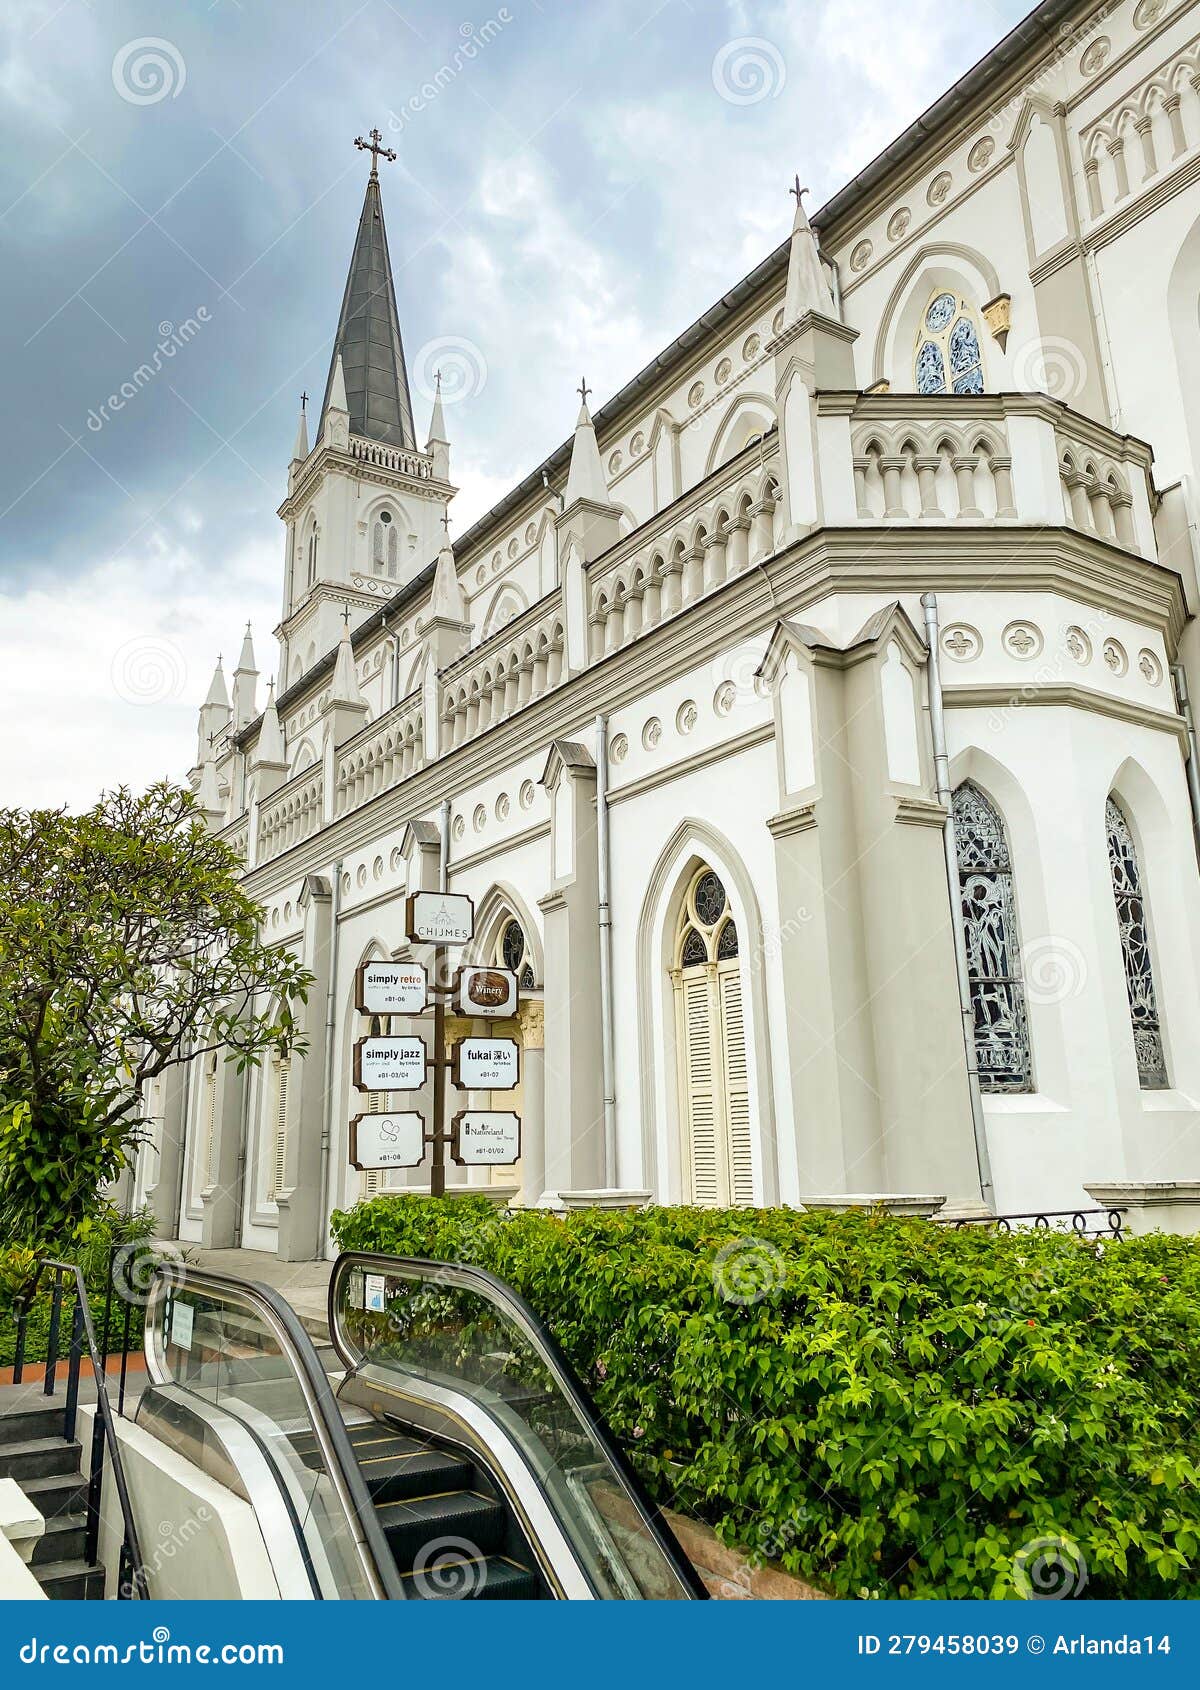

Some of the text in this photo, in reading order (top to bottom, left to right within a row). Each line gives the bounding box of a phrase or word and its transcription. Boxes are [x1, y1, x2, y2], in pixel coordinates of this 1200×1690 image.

[418, 926, 468, 938] CHIJMES
[368, 974, 421, 984] simply retro
[475, 985, 503, 996] Winery
[366, 1049, 420, 1060] simply jazz
[468, 1050, 492, 1060] fukai
